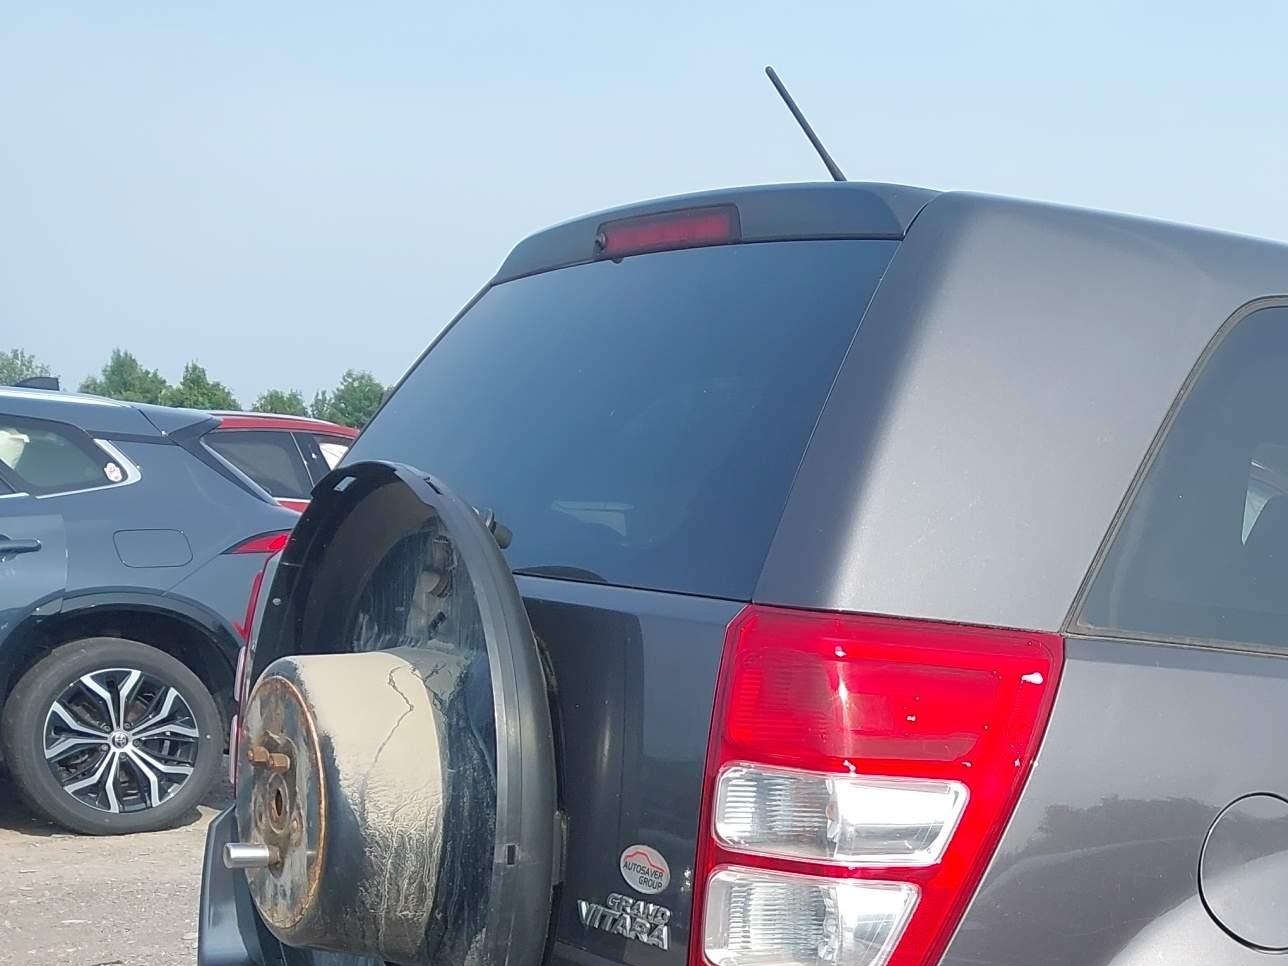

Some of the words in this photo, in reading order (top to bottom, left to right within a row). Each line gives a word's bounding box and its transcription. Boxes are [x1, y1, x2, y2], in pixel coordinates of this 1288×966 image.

[623, 861, 664, 880] AUTOSAVER
[638, 876, 662, 890] GROUP
[606, 893, 671, 925] GRAND
[577, 899, 669, 951] VITARA
